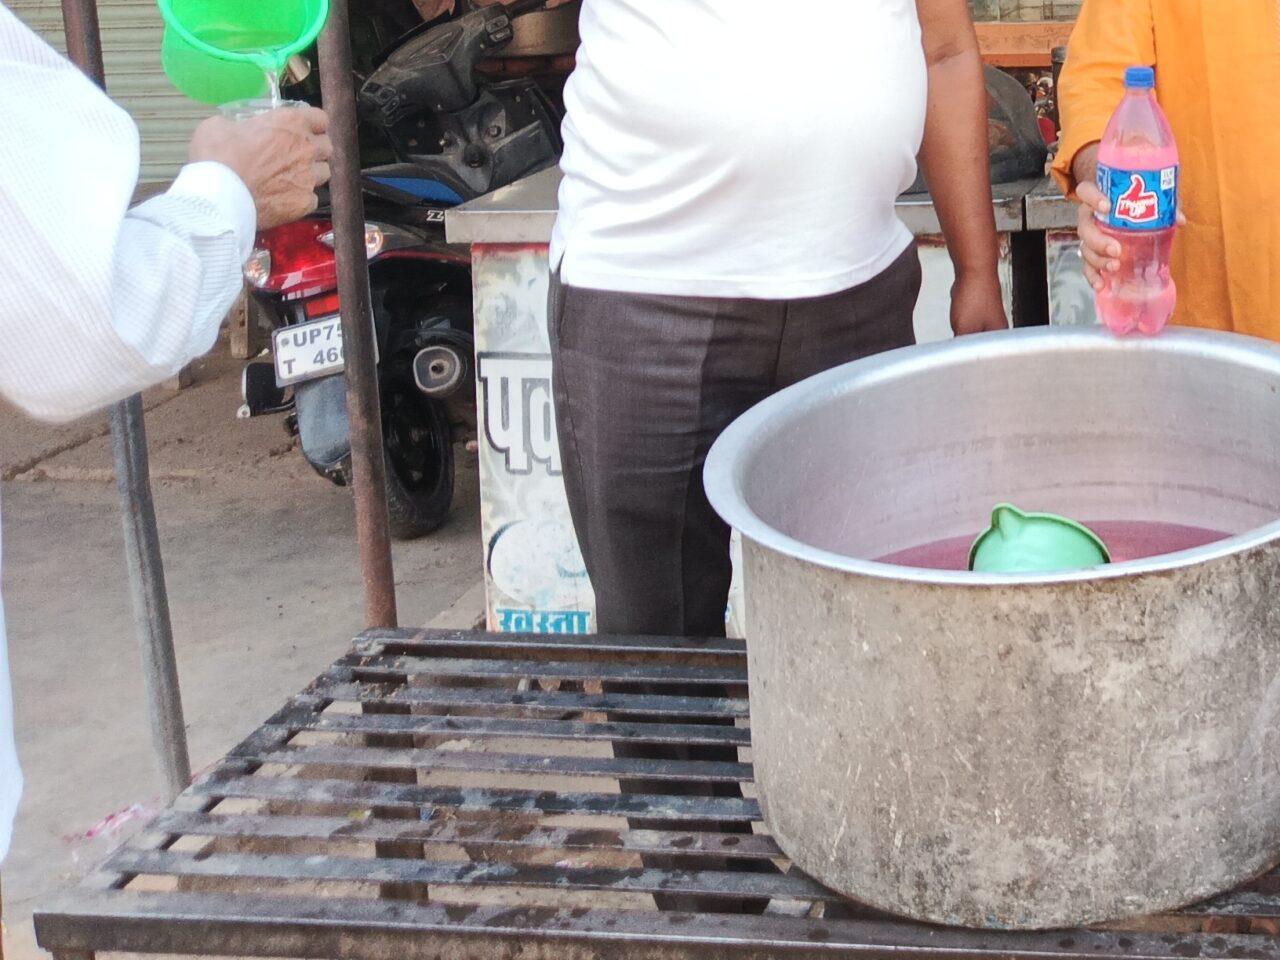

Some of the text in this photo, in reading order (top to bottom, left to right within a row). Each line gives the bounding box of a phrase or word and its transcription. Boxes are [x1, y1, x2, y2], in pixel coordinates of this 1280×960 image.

[283, 344, 344, 376] T 46
[477, 352, 563, 475] पव
